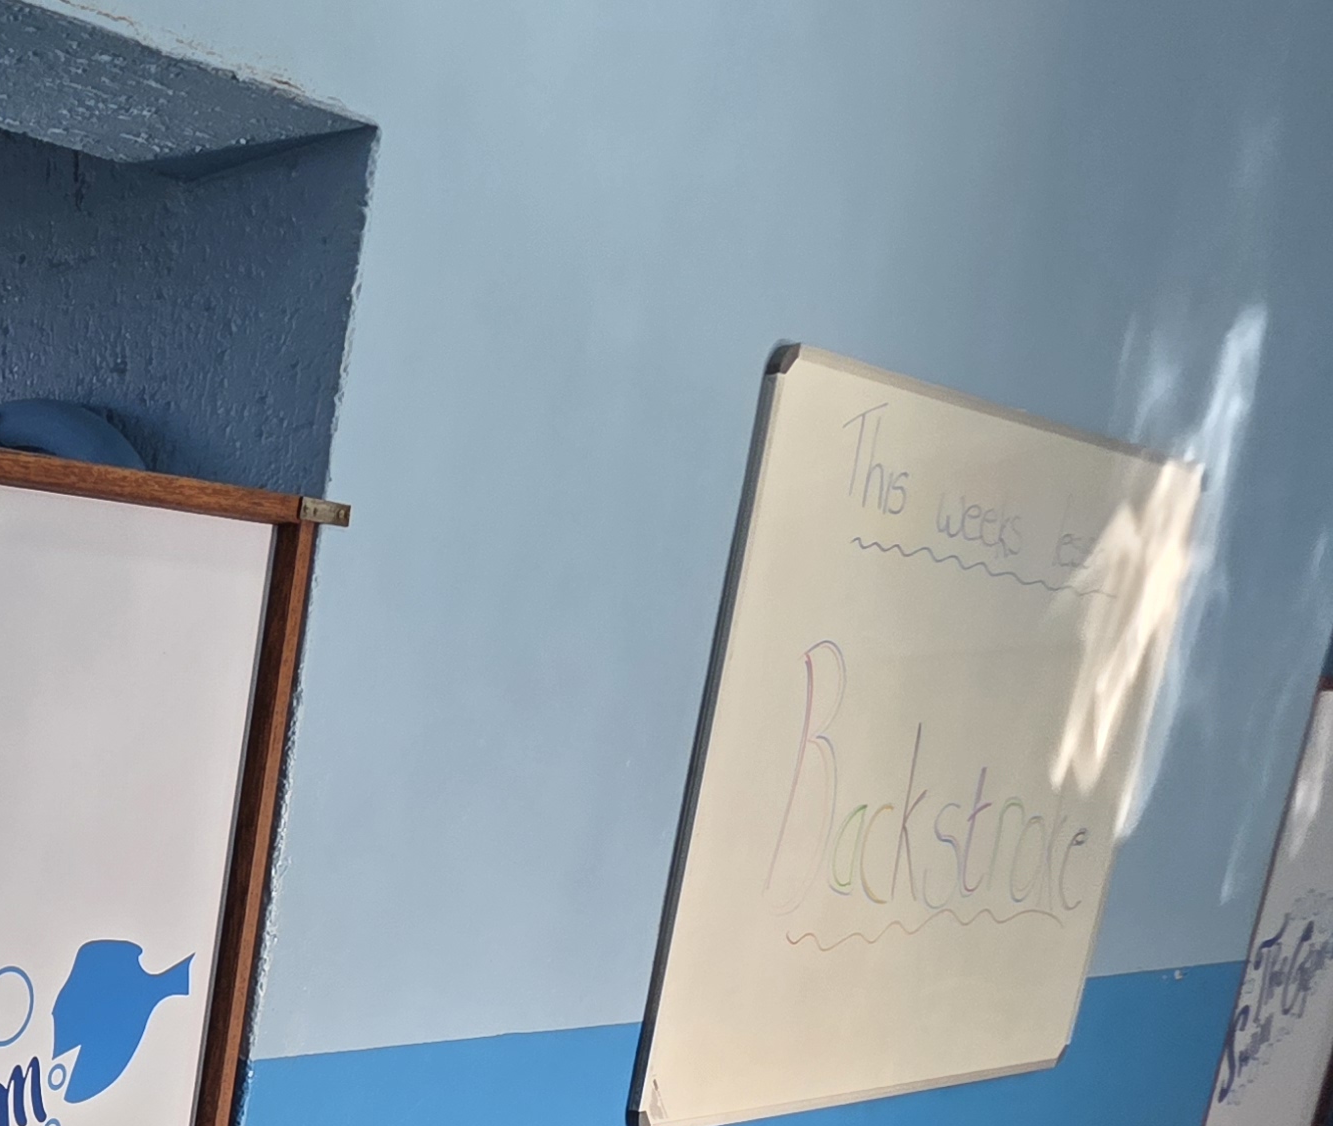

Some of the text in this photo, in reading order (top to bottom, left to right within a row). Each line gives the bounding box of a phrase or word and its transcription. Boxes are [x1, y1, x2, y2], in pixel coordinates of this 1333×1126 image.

[843, 402, 909, 515] This
[936, 493, 1023, 559] weeks
[762, 639, 1089, 917] Backstroke
